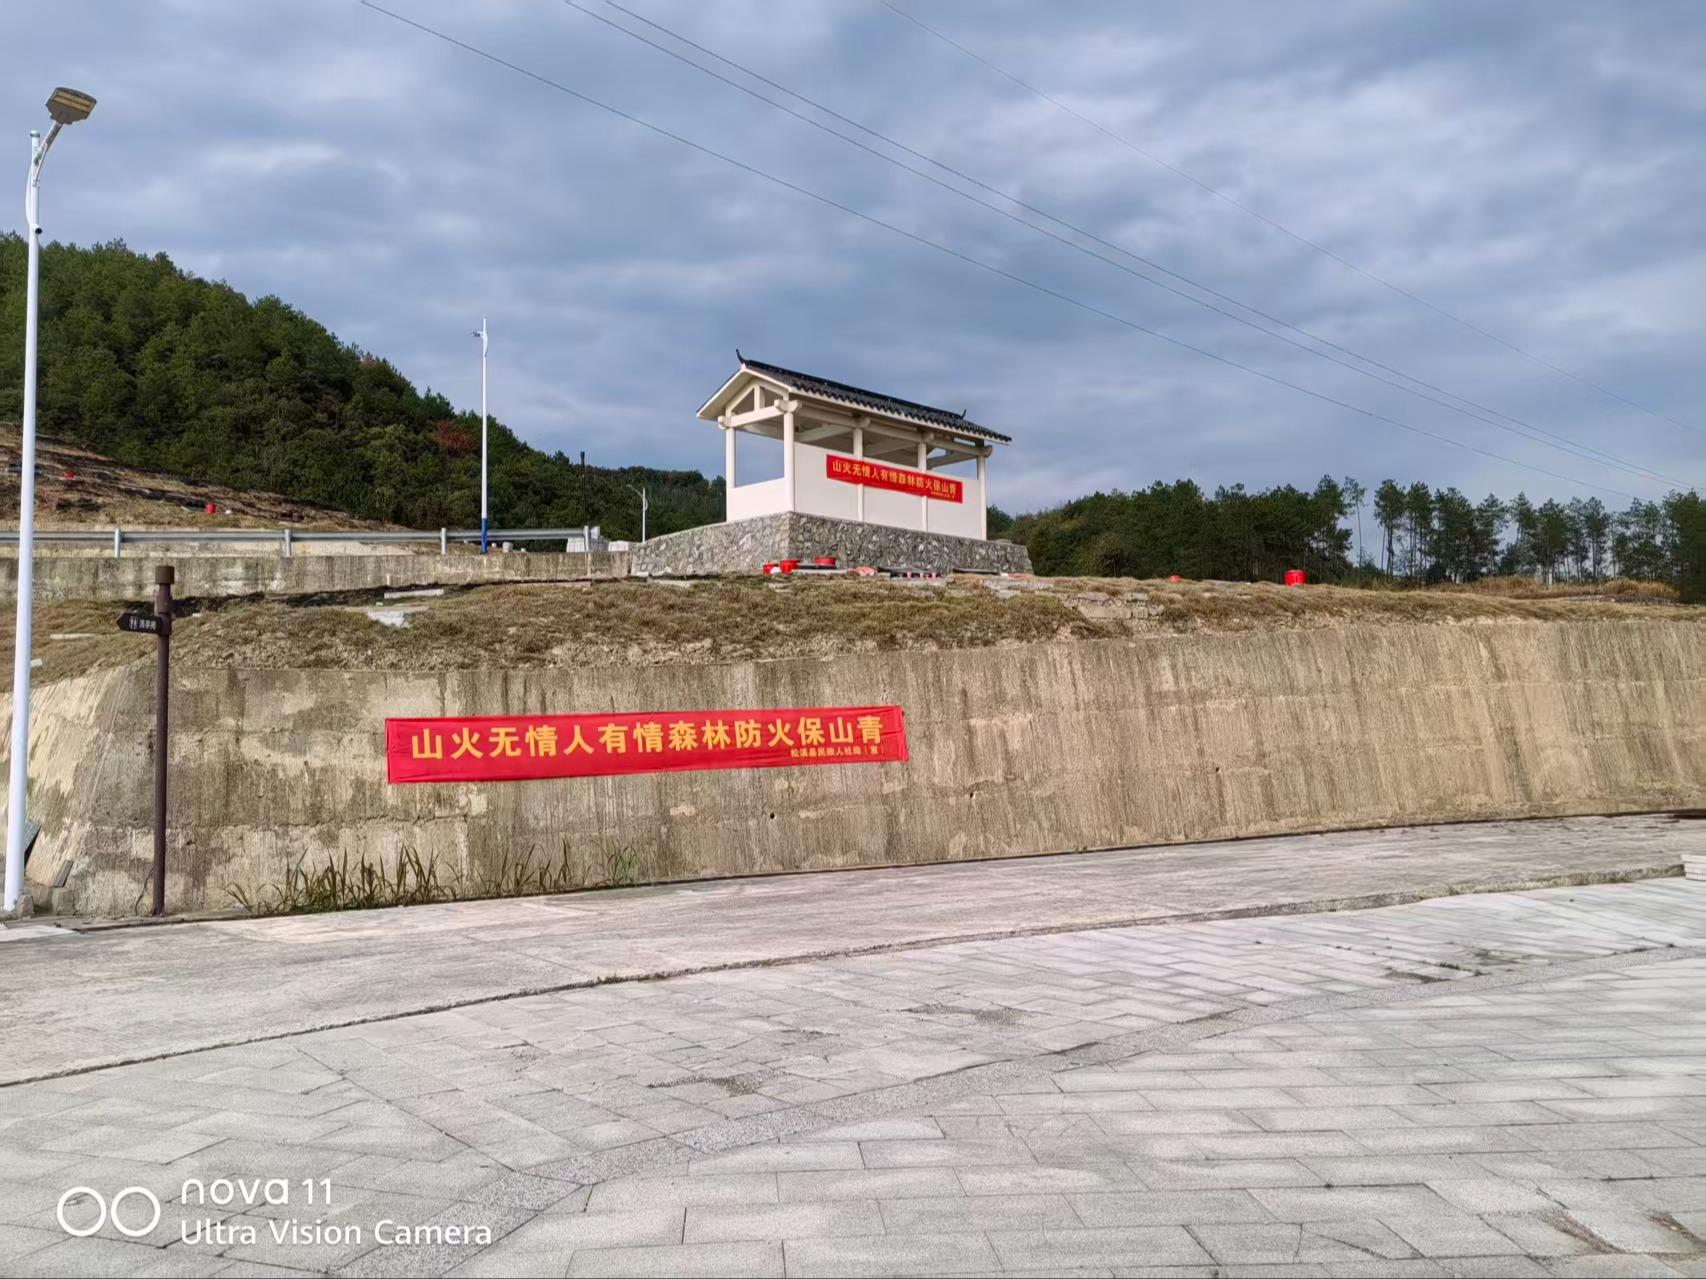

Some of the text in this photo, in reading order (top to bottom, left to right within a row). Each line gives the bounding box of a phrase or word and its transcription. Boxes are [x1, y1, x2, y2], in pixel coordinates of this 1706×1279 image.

[412, 715, 883, 759] 山火无情人有情森林防火保山青
